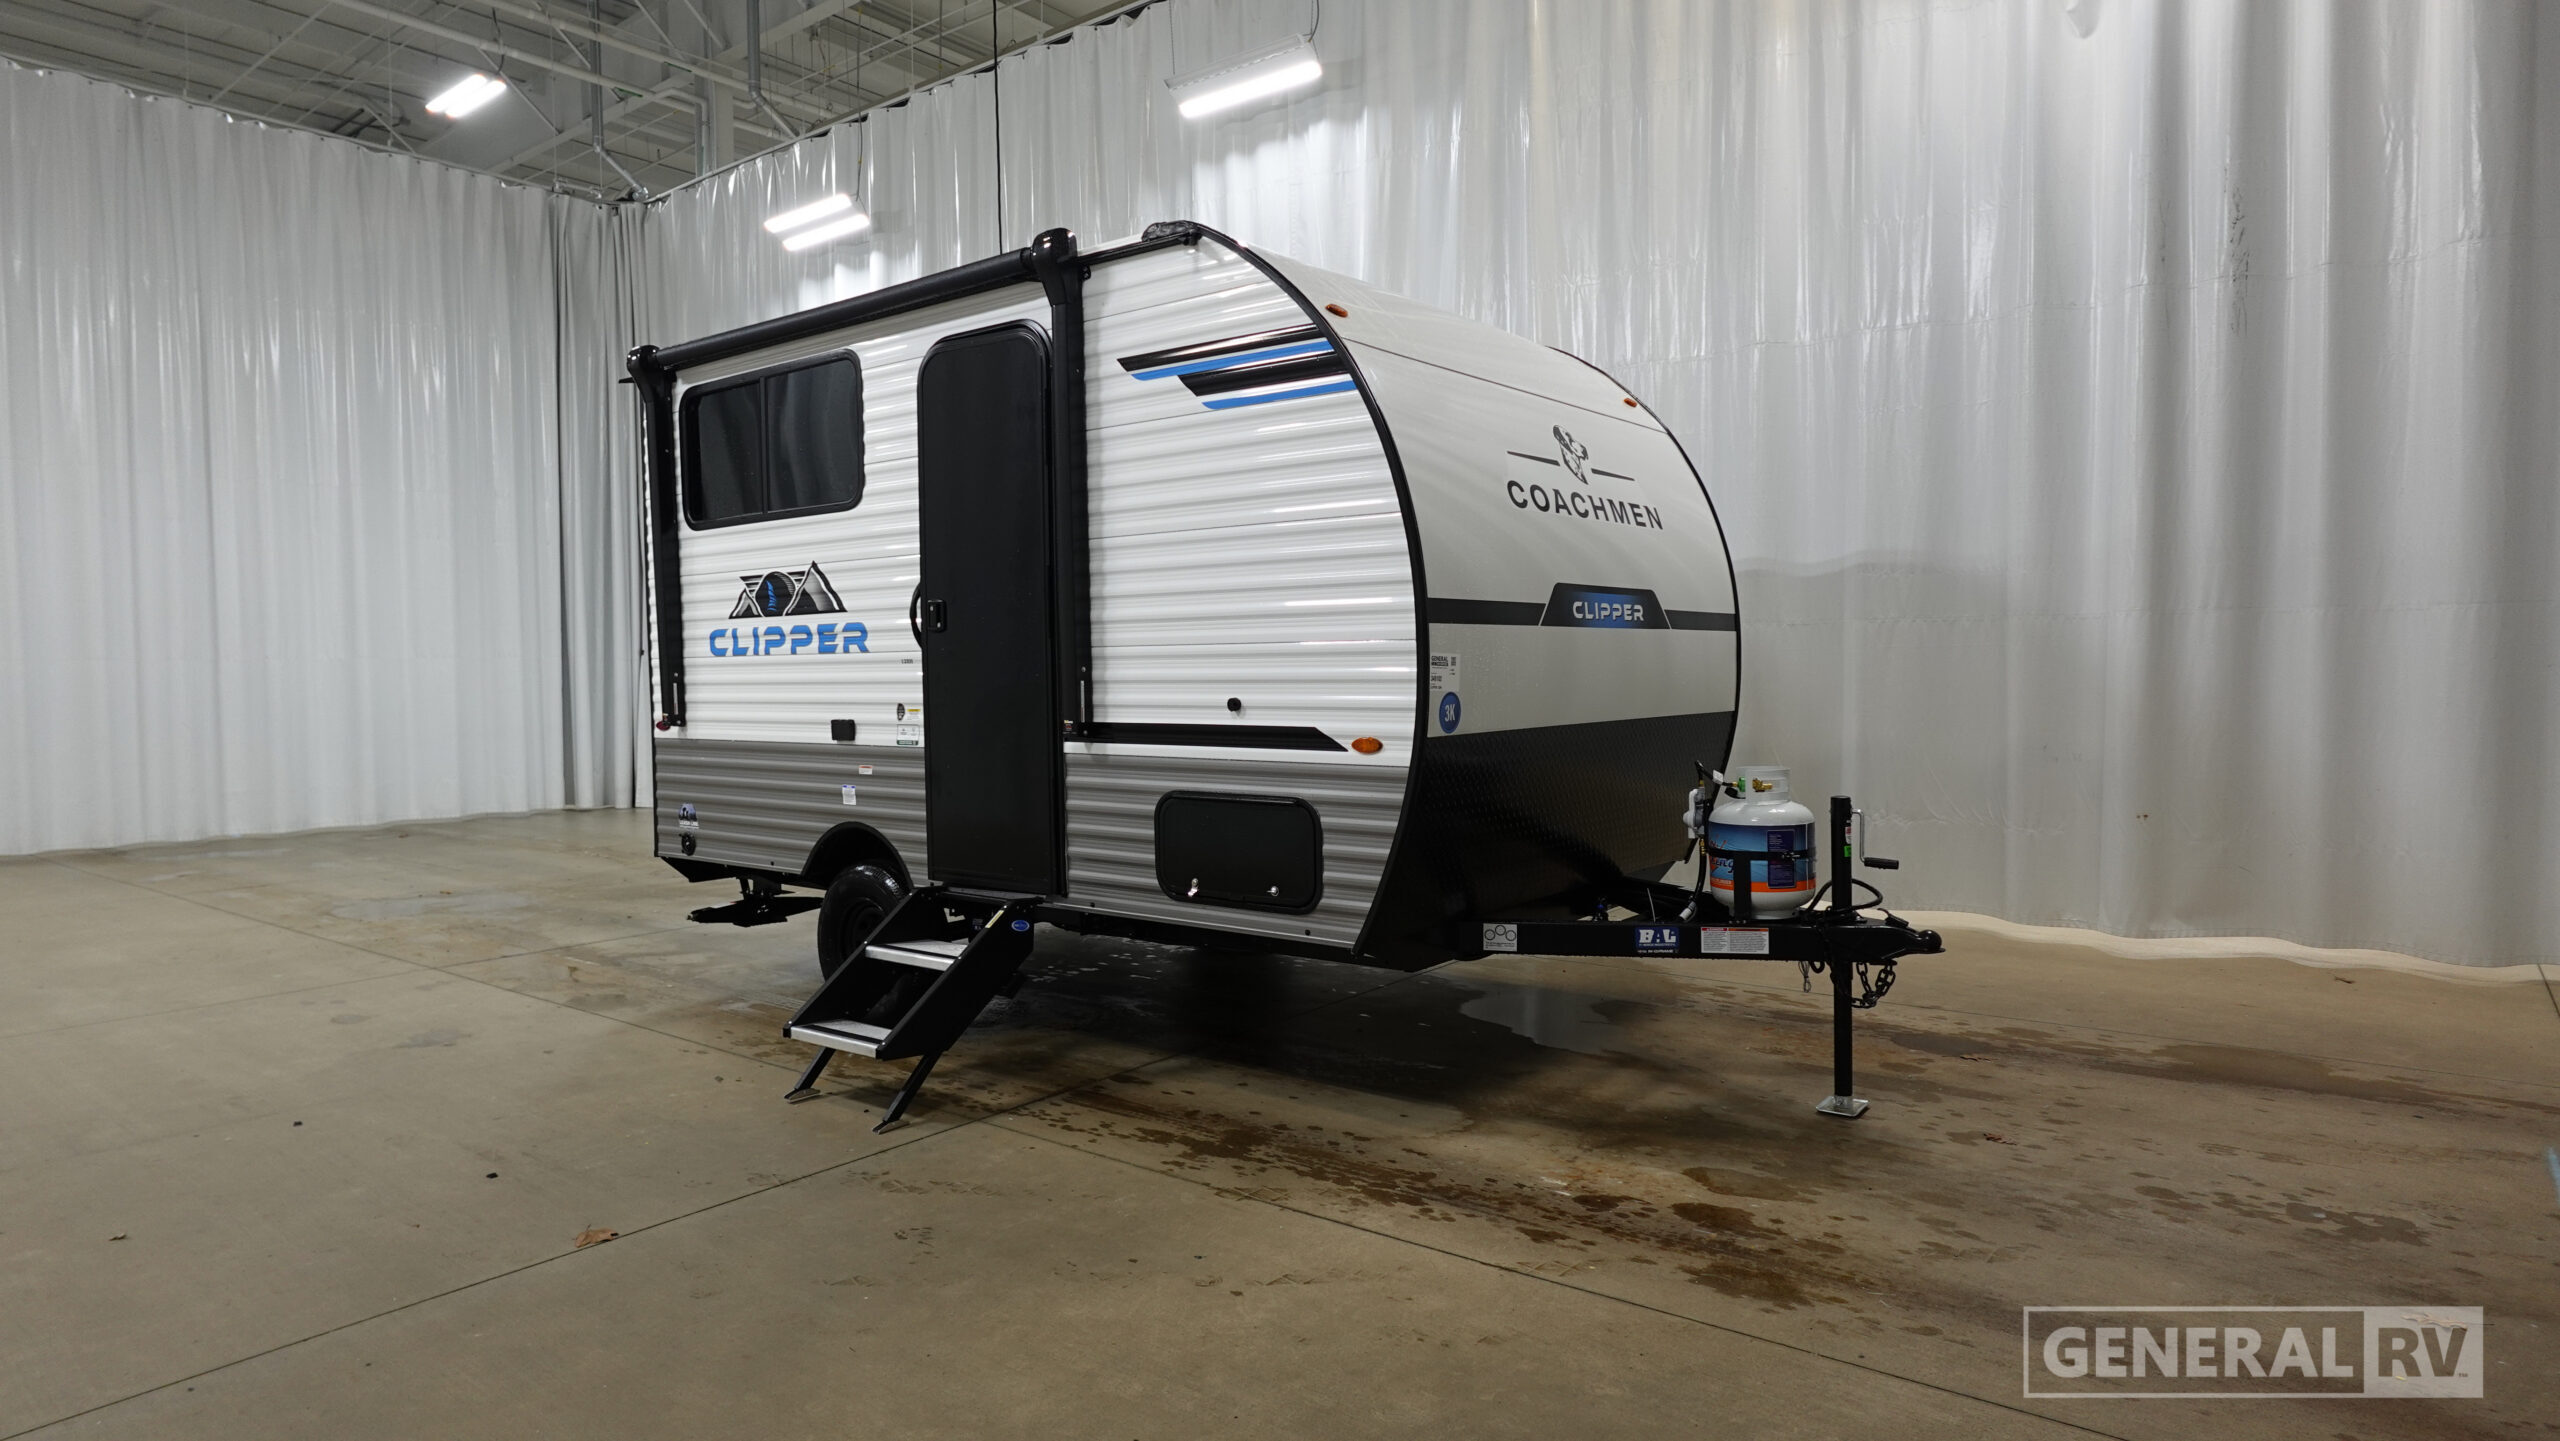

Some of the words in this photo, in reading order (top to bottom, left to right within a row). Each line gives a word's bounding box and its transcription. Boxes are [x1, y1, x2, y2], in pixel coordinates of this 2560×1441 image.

[1507, 480, 1664, 530] COACHMEN
[1572, 601, 1645, 622] CLIPPER
[709, 622, 869, 656] CLIPPER
[1444, 703, 1456, 722] 3K
[1639, 929, 1677, 943] BAL
